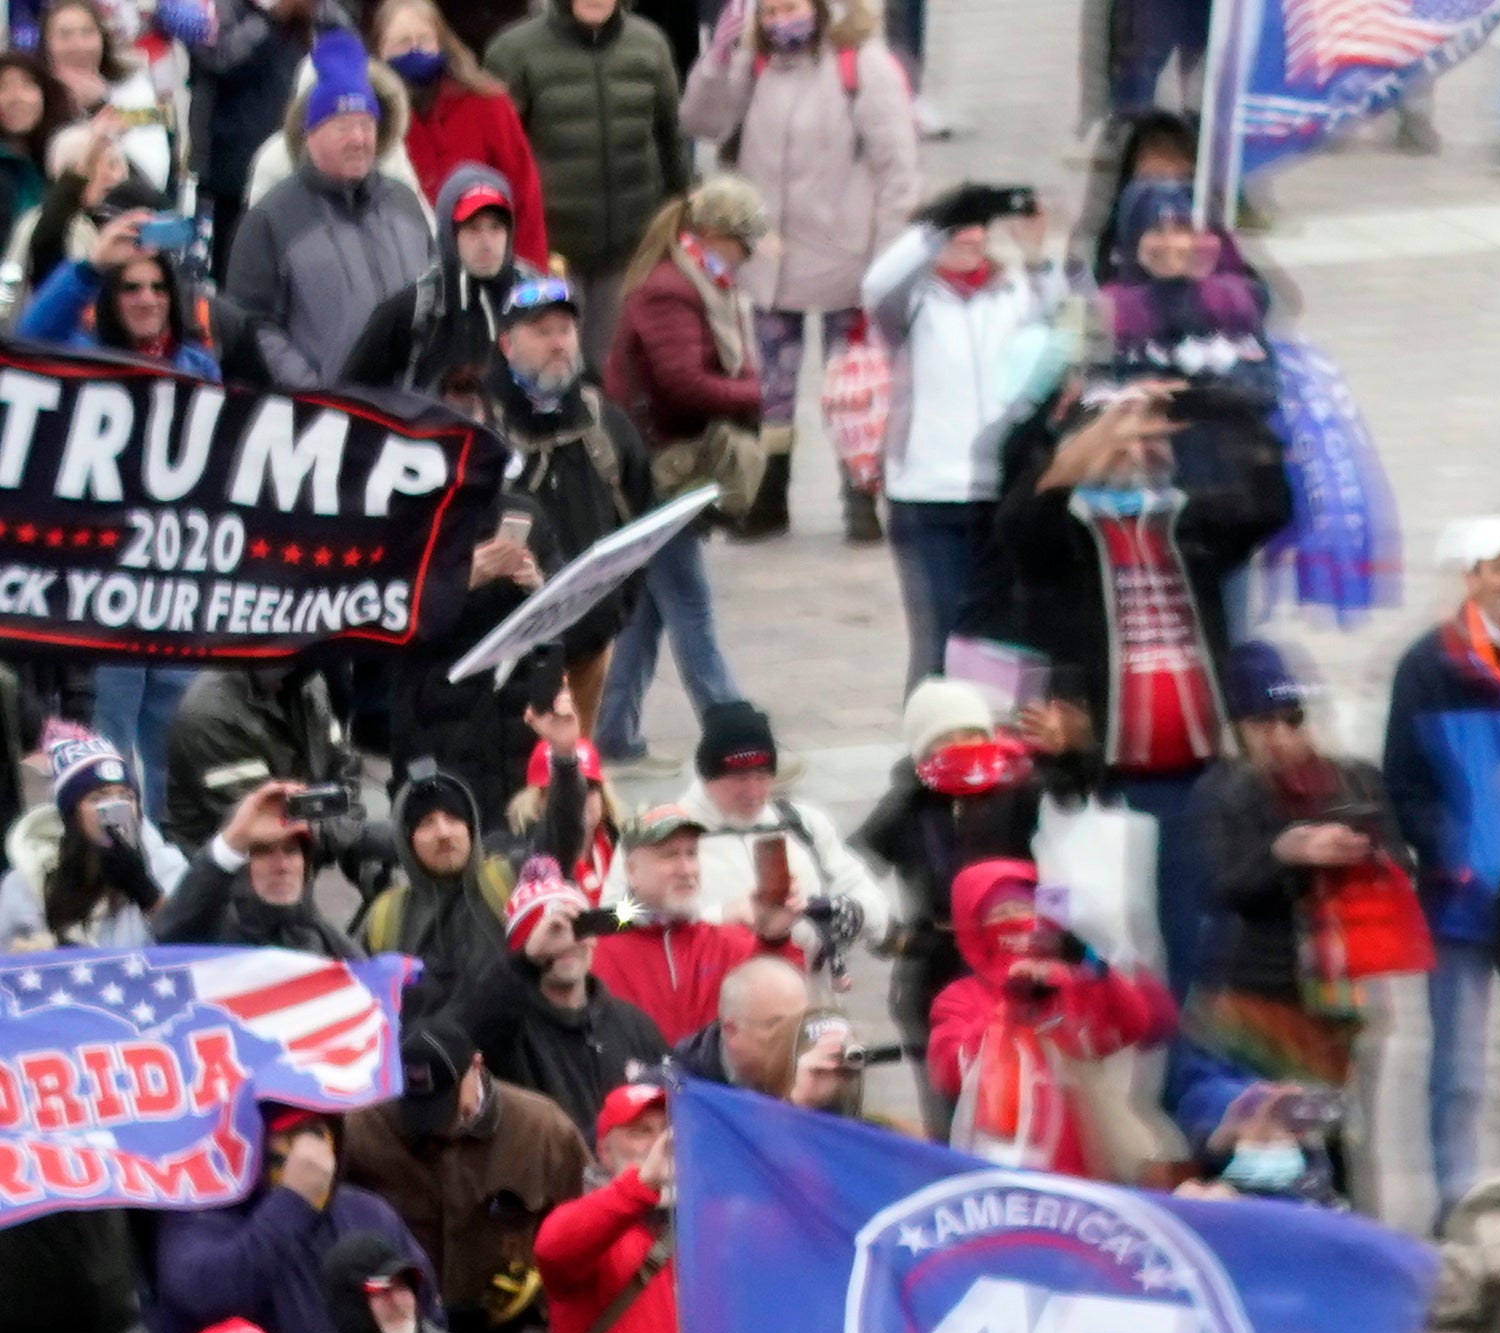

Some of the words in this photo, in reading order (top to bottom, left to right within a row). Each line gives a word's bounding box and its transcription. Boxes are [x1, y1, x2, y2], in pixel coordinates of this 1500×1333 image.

[0, 369, 448, 517] TRUMP
[118, 510, 247, 573] 2020
[65, 570, 202, 633] YOUR
[206, 580, 410, 634] FEELINGS
[933, 1194, 1135, 1266] AMERICA
